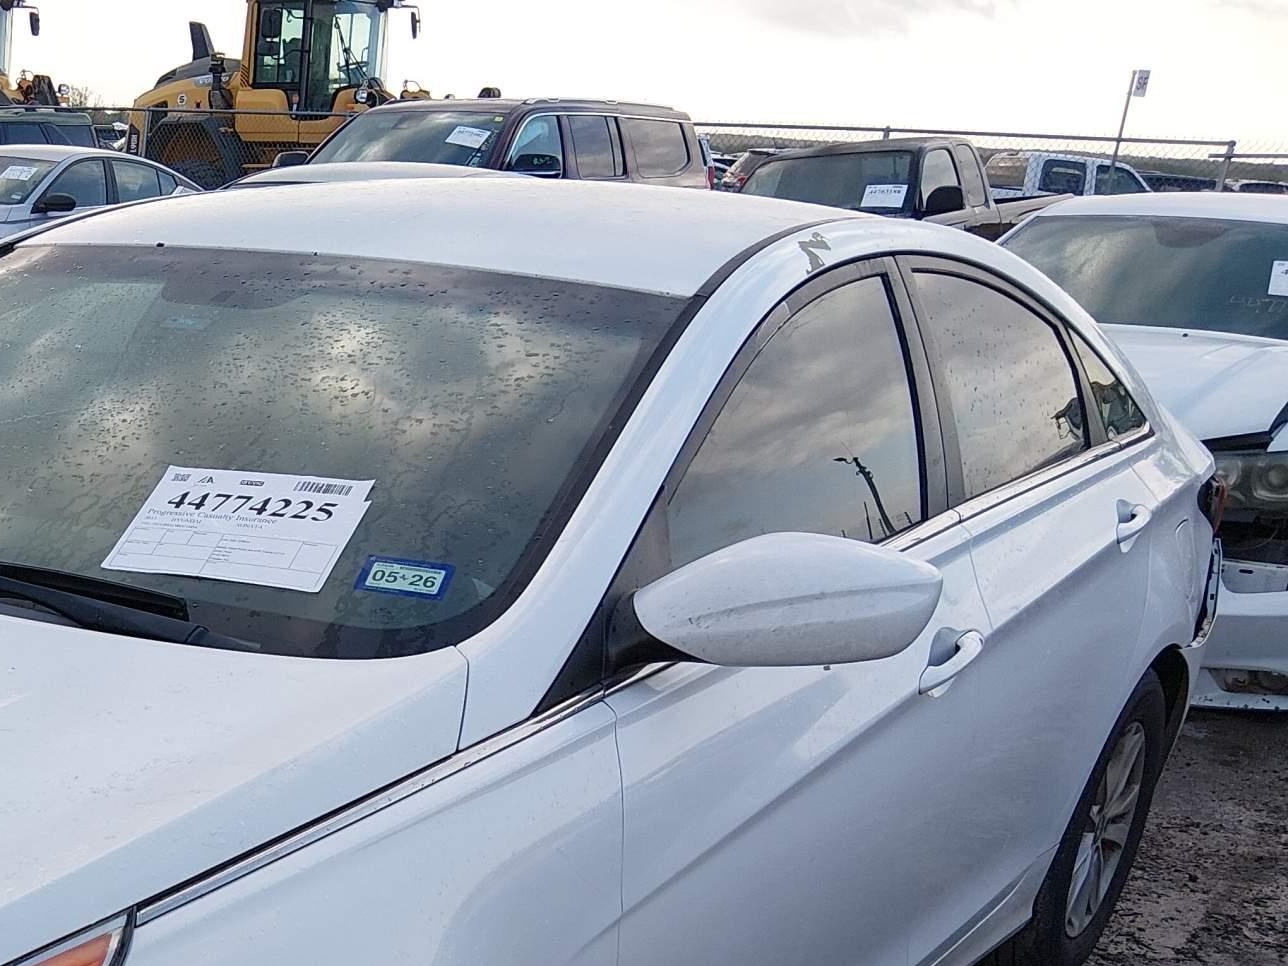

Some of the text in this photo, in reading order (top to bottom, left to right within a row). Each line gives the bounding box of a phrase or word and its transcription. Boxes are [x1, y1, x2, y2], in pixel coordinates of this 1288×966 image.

[168, 490, 339, 522] 44774225
[147, 508, 278, 525] Progressive Casualty Insurance
[371, 569, 401, 584] 05
[408, 574, 438, 589] 26
